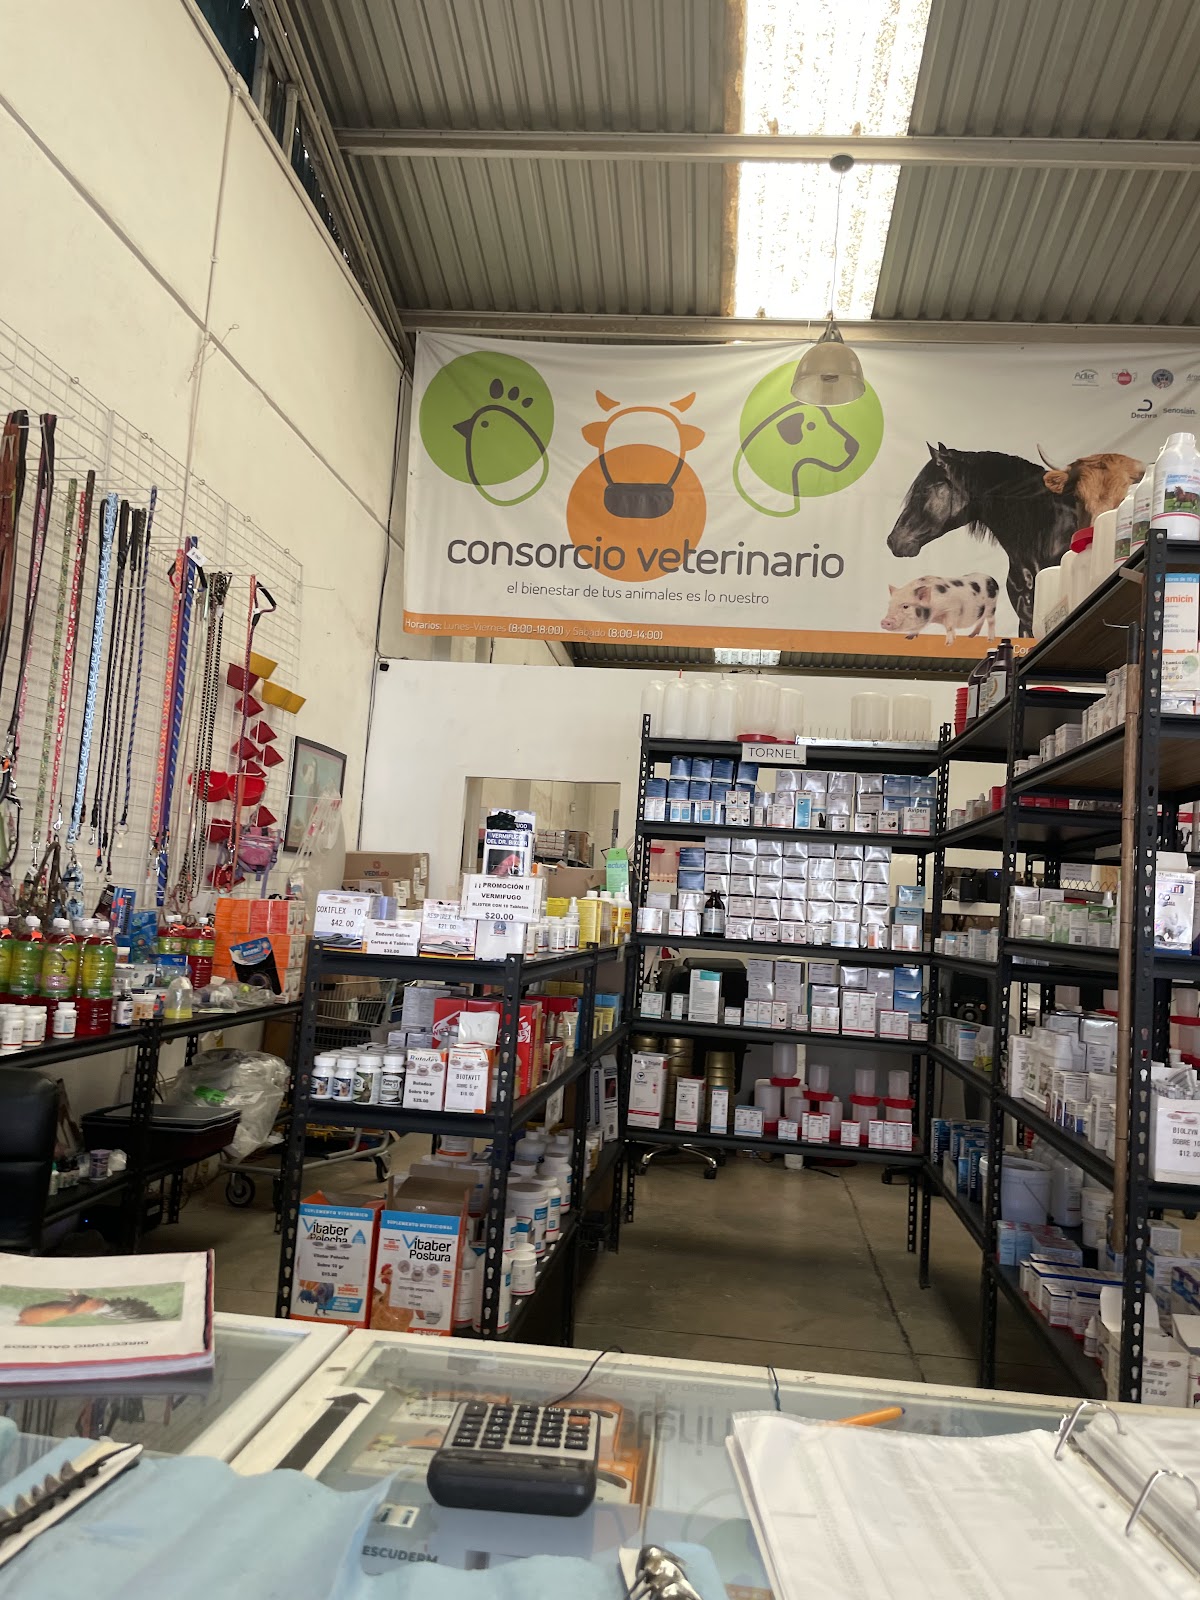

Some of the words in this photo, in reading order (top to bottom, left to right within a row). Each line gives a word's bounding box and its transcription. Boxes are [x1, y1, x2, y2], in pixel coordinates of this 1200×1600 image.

[447, 536, 626, 571] consorcio
[637, 538, 845, 579] veterinario
[506, 581, 518, 594] el
[521, 582, 580, 597] bienestar
[583, 584, 599, 598] de
[602, 586, 622, 599] tus
[624, 587, 683, 601] animales
[686, 590, 701, 602] es
[704, 589, 716, 602] lo
[719, 593, 769, 604] nuestro
[405, 618, 442, 630] Horarios:
[748, 747, 800, 759] TORNEL
[316, 905, 347, 914] COXIFLEX
[484, 912, 514, 920] $20.00
[331, 918, 355, 928] $42.00
[456, 1073, 481, 1081] BIOTAVIT
[302, 1217, 350, 1236] Vitater
[402, 1234, 452, 1252] Vitater
[409, 1250, 451, 1262] Postura
